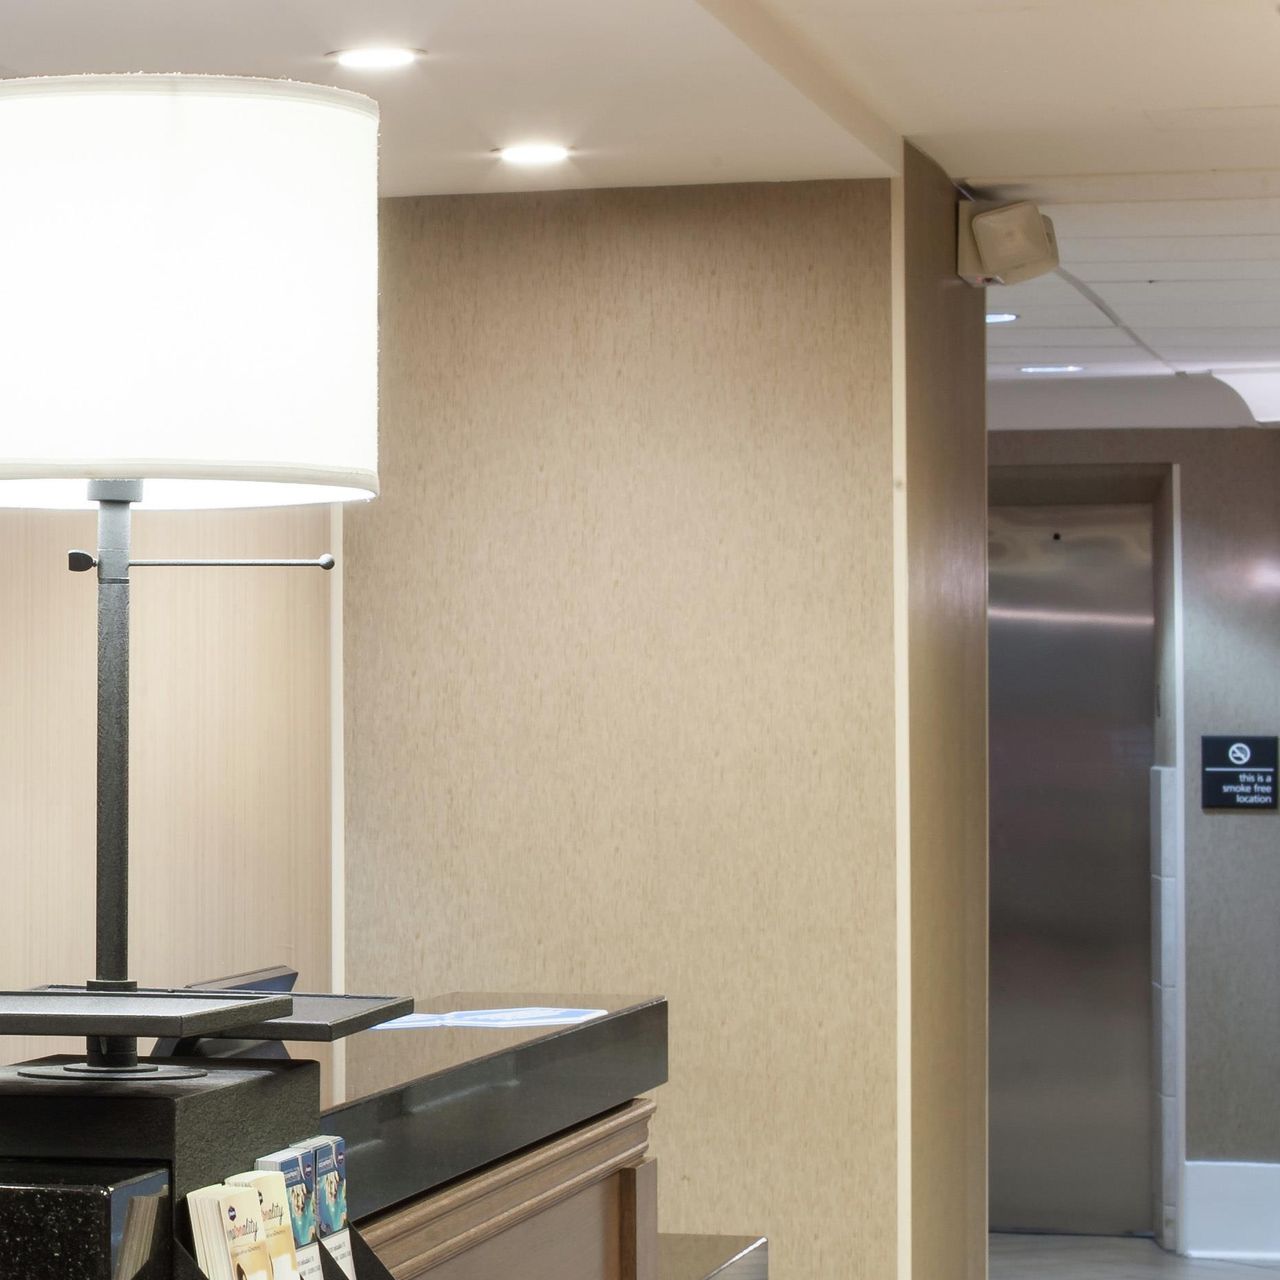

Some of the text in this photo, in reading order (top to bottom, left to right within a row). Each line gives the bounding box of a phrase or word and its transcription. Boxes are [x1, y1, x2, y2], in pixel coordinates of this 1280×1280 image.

[1239, 774, 1272, 783] this is a
[1222, 784, 1272, 793] smoke free
[1236, 794, 1272, 803] location
